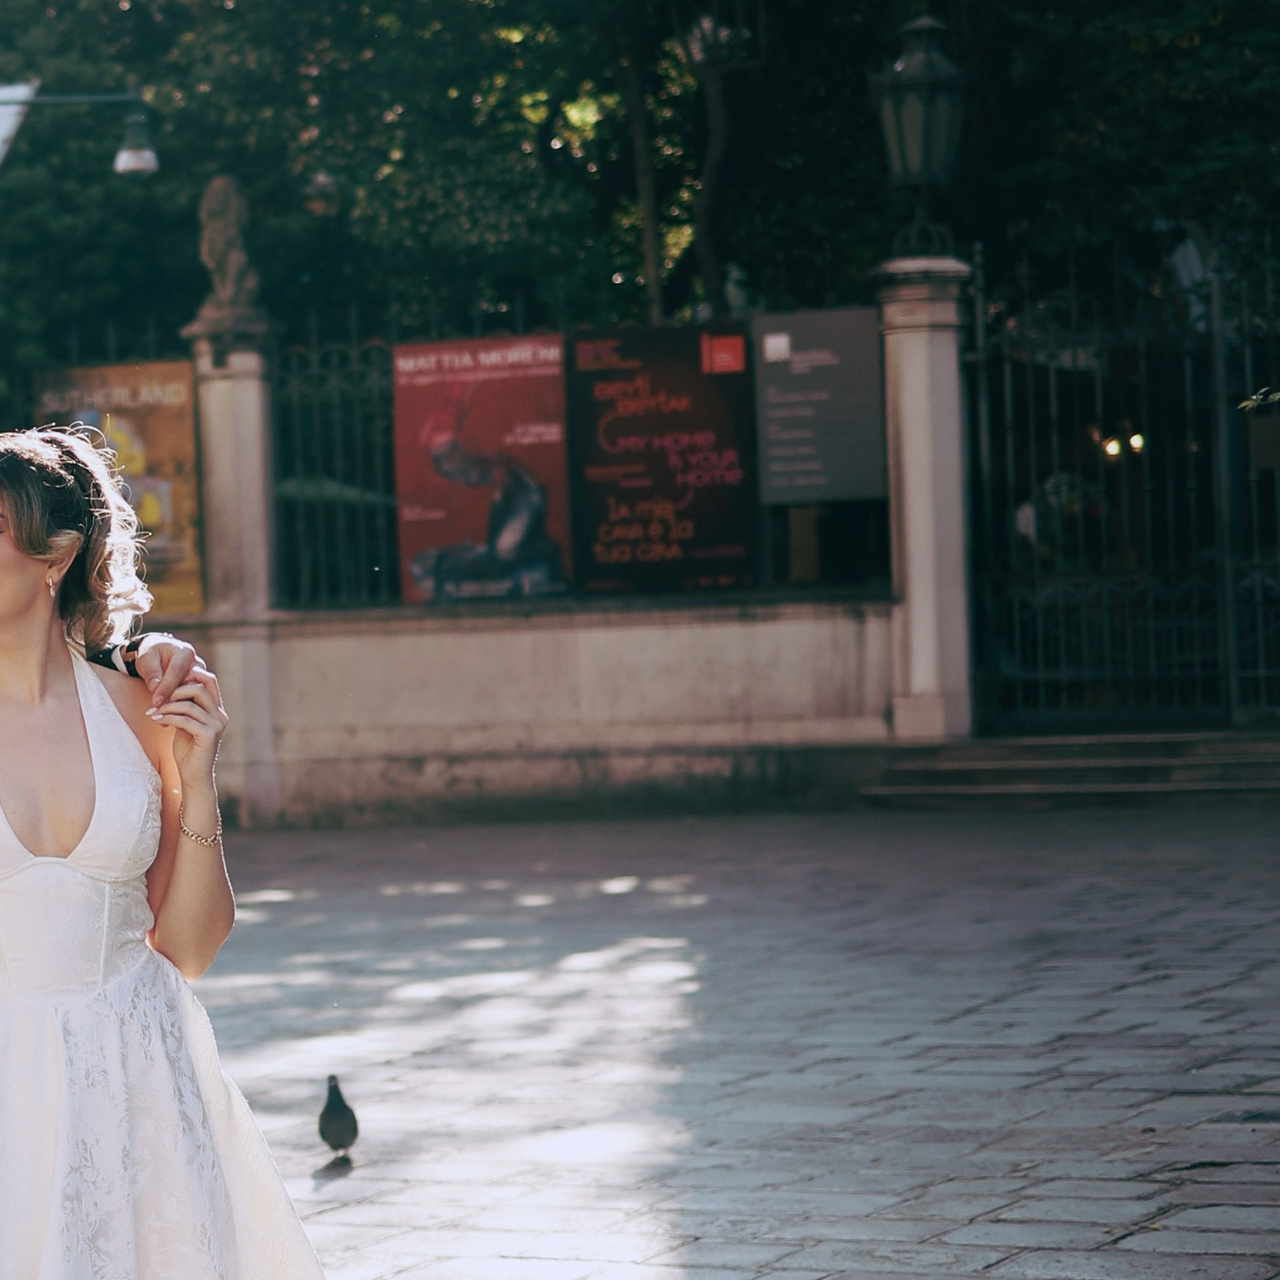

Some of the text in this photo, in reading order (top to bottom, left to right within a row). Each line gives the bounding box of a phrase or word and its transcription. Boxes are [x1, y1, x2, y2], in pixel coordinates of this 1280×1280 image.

[396, 351, 474, 372] MATTIA
[477, 342, 561, 366] MORENI
[40, 382, 188, 413] SUTHERLAND
